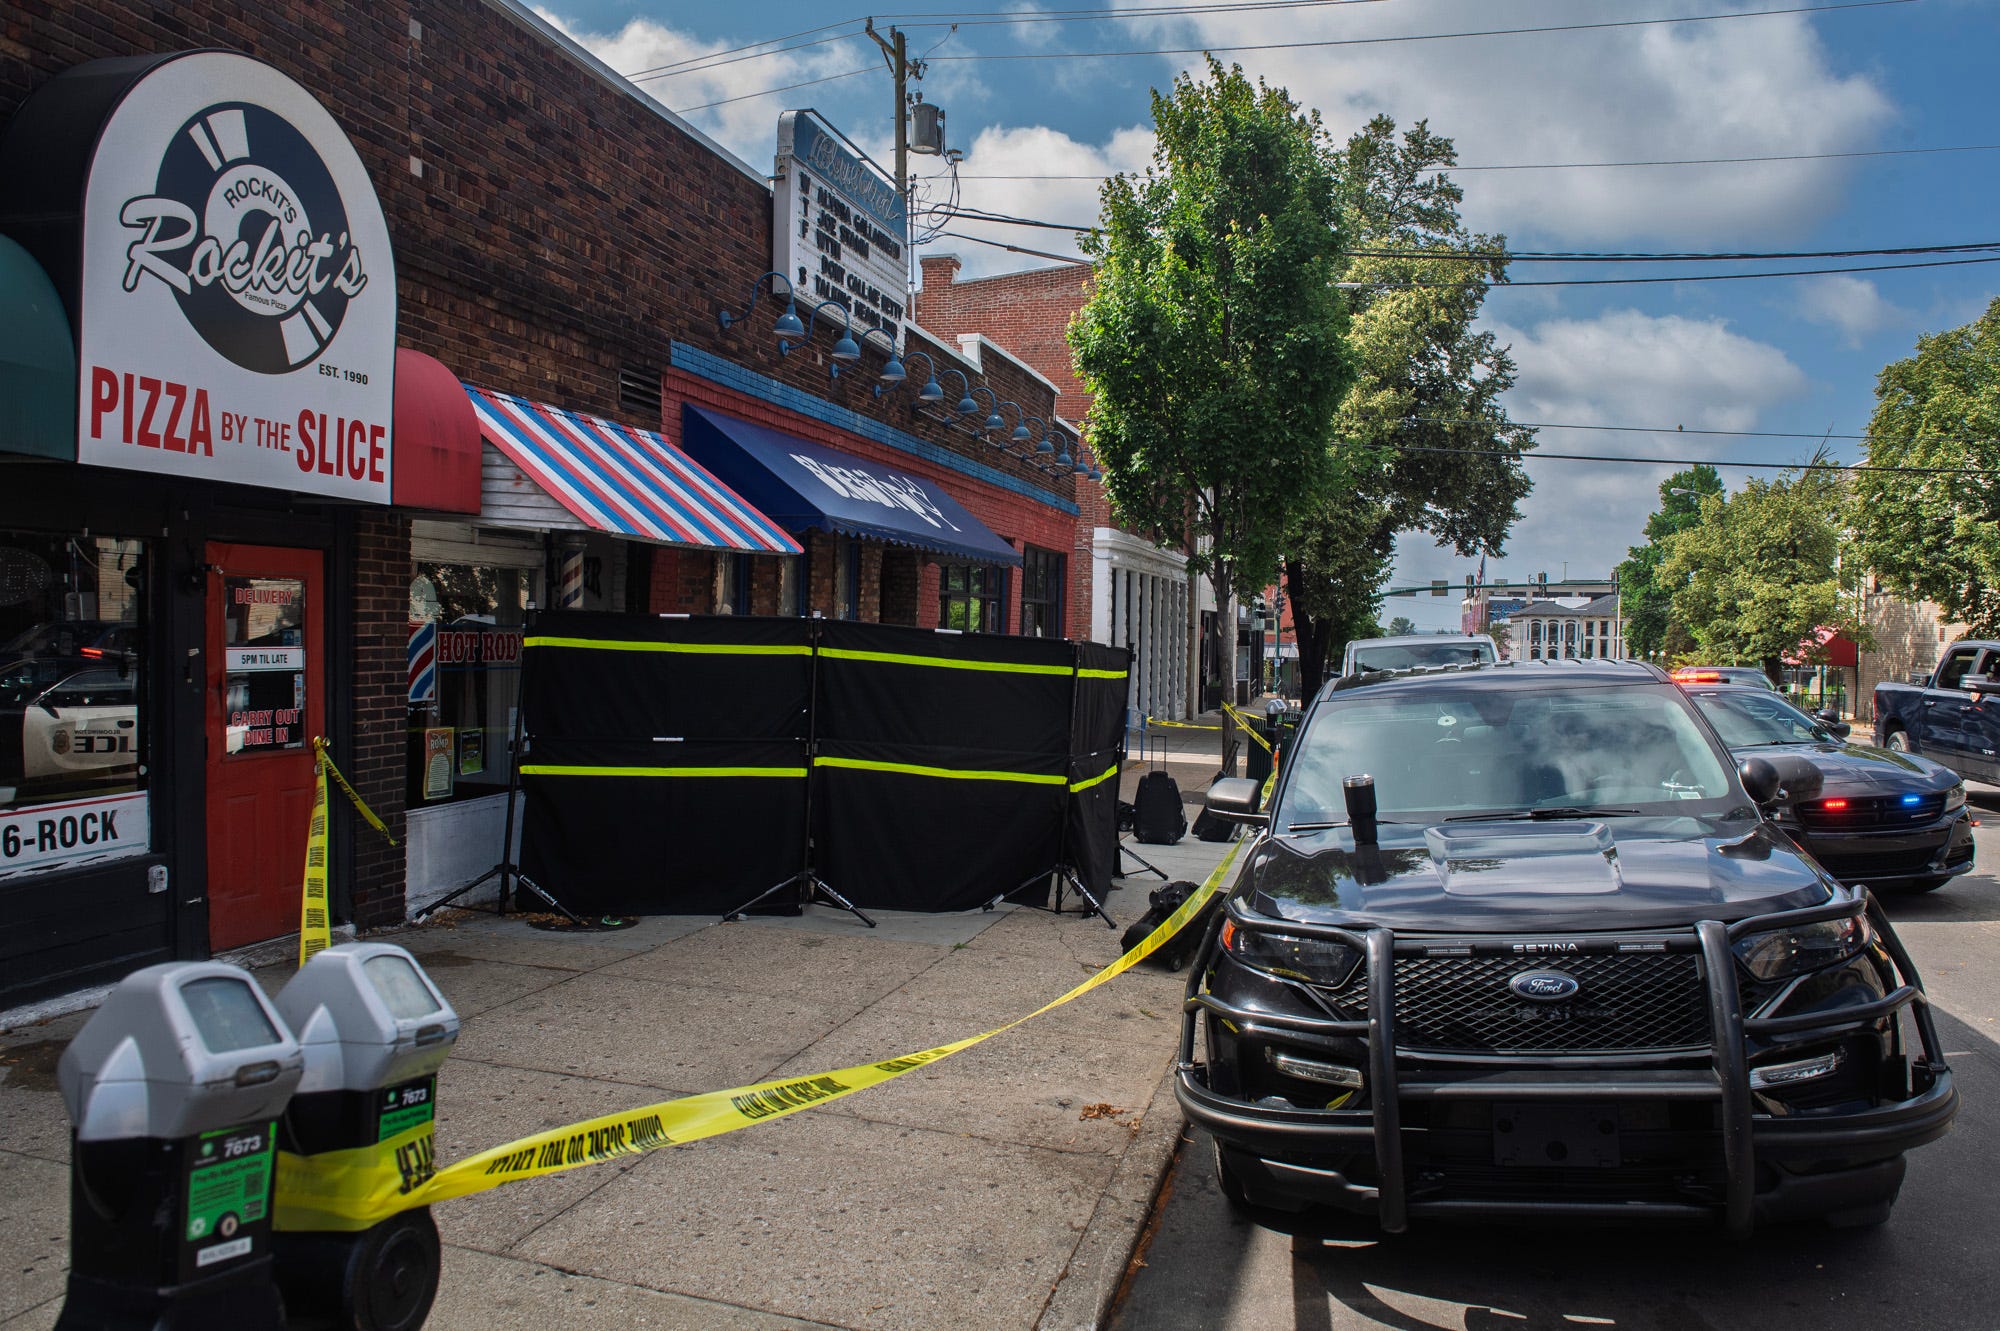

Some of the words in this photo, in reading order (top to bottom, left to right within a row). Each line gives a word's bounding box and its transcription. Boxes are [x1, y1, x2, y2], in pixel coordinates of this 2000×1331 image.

[223, 178, 297, 224] ROCKIT'S
[803, 197, 810, 217] T
[817, 209, 837, 237] JOE
[802, 219, 809, 239] F
[119, 194, 368, 299] Rockit's
[244, 291, 270, 307] Famous
[271, 297, 288, 311] Pizza
[319, 363, 340, 379] EST.
[343, 369, 369, 385] 1990
[91, 365, 214, 457] PIZZA
[221, 411, 247, 444] BY
[254, 418, 291, 452] THE
[296, 408, 385, 483] SLICE
[235, 587, 293, 605] DELIVERY
[437, 631, 480, 664] HOT
[241, 654, 257, 665] 5PM
[259, 654, 269, 665] TIL
[272, 654, 288, 665] LATE
[231, 709, 273, 727] CARRY
[275, 708, 299, 725] OUT
[244, 728, 272, 746] DINE
[275, 727, 289, 744] IN
[1512, 943, 1578, 953] SETINA
[1528, 979, 1564, 993] Ford
[402, 1088, 427, 1106] 7673
[224, 1135, 262, 1158] 7673
[588, 1123, 643, 1161] SCENE
